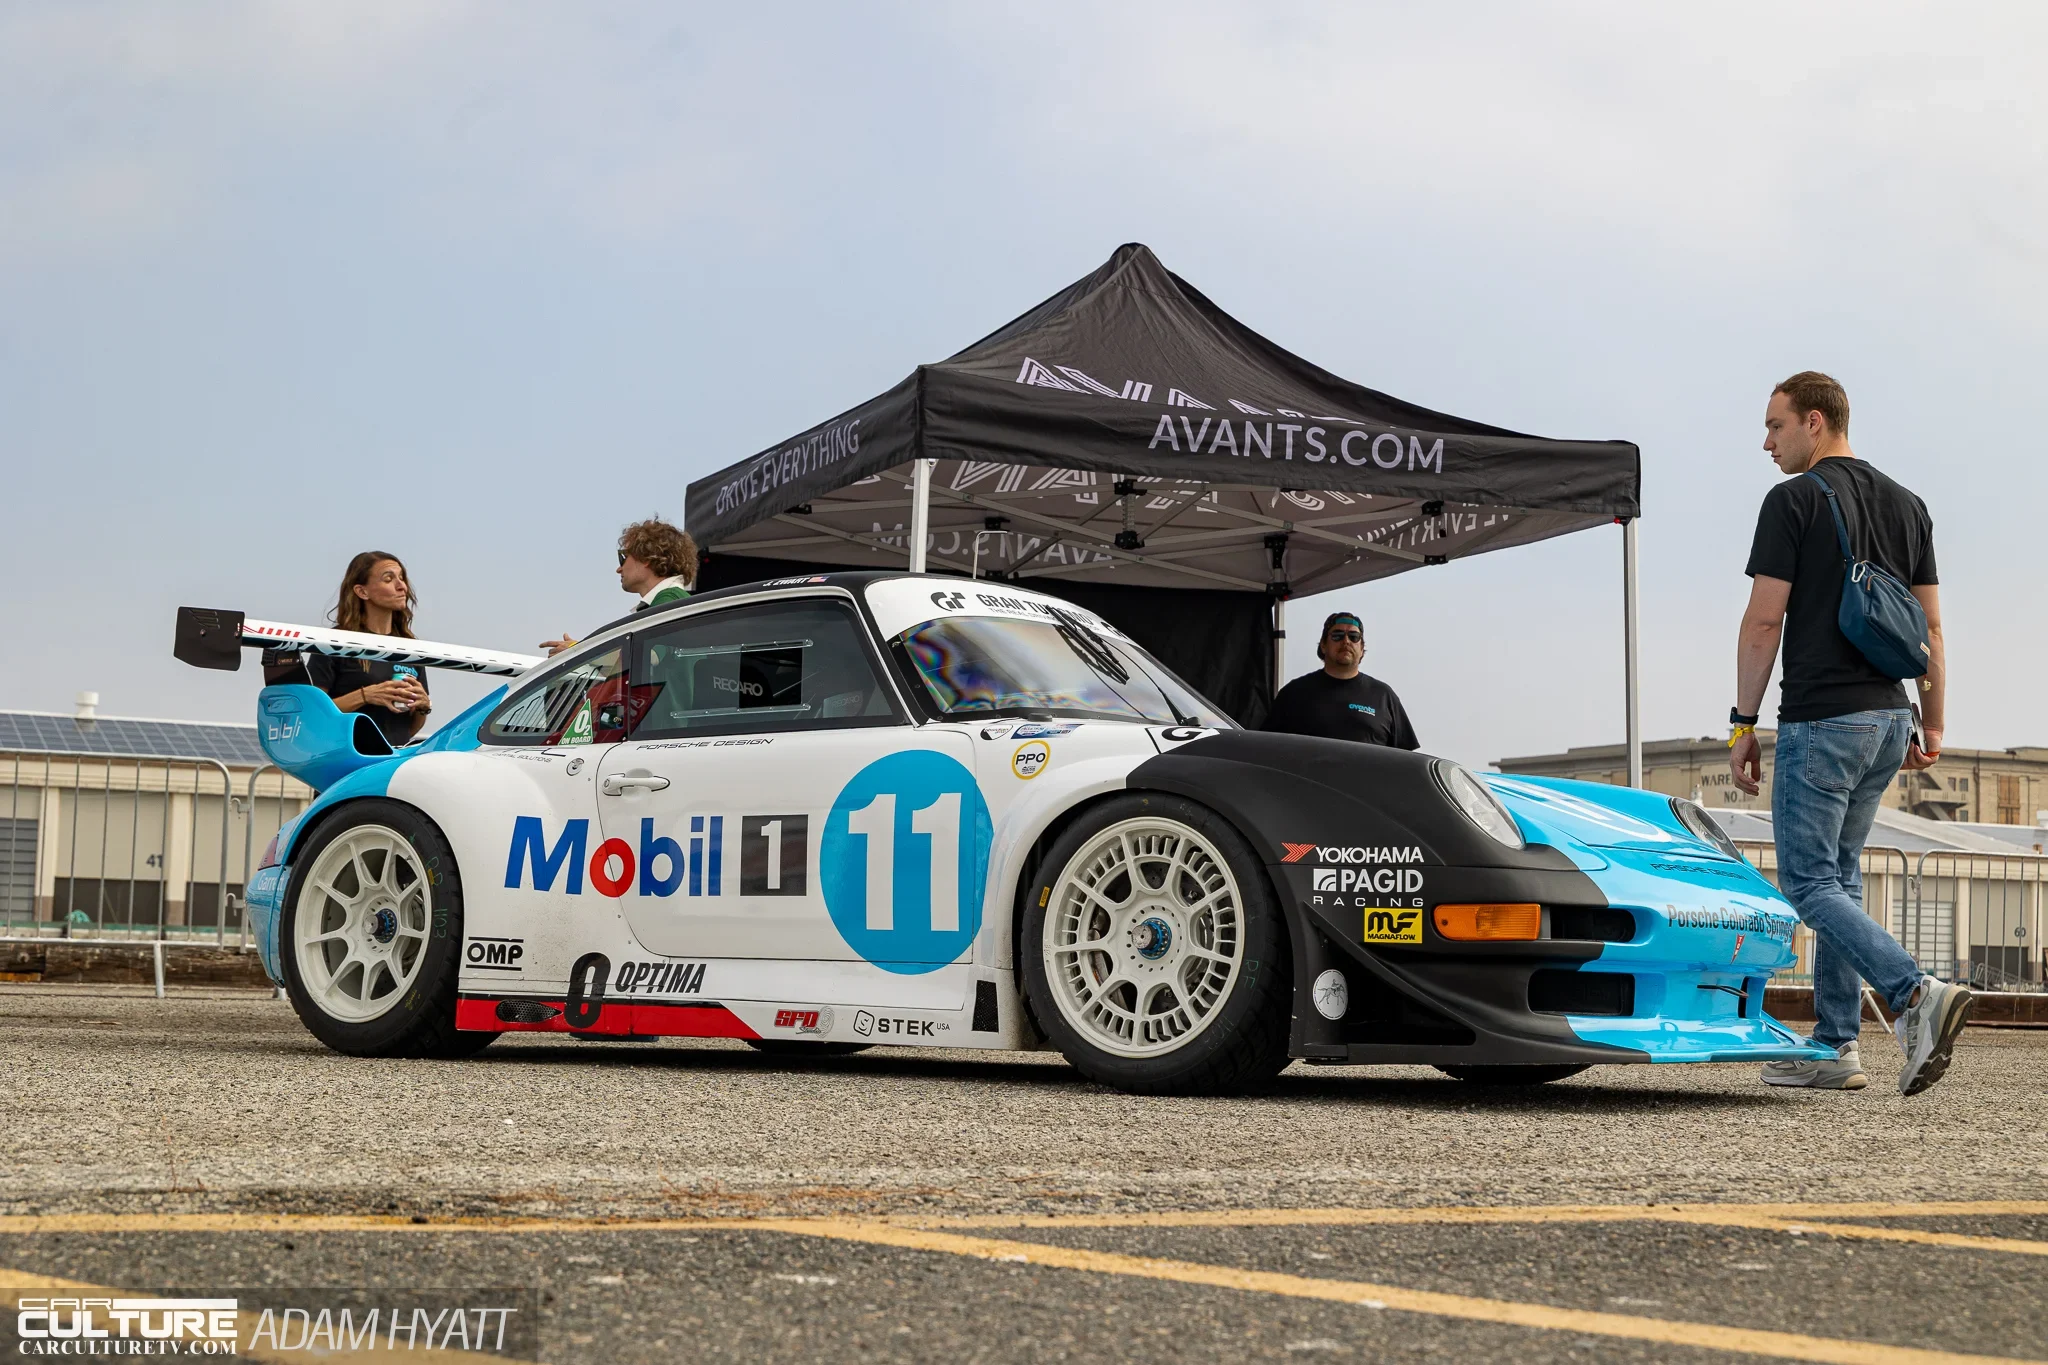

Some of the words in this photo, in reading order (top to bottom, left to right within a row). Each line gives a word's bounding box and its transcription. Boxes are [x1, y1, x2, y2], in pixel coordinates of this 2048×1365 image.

[1148, 414, 1444, 474] AVANTS.COM
[715, 466, 760, 516] DRIVE
[760, 419, 861, 494] EVERYTHING
[975, 593, 1026, 611] GRAN
[713, 676, 764, 697] RECARO
[561, 737, 570, 745] ON
[571, 735, 591, 744] BOARD
[636, 741, 712, 751] PORSCHE
[713, 738, 774, 748] DESIGN
[1015, 752, 1047, 766] PPO
[1701, 771, 1767, 787] WAREE
[146, 854, 163, 868] 41
[504, 815, 724, 899] Mobil
[759, 820, 783, 890] 1
[847, 791, 963, 933] 11
[1315, 846, 1425, 864] YOKOHAMA
[1341, 868, 1424, 893] PAGID
[1313, 895, 1424, 908] RACING
[1666, 904, 1719, 928] Porsche
[1719, 907, 1765, 933] Colorado
[1764, 912, 1794, 944] Springs
[1367, 933, 1416, 941] MAGNAFLOW
[466, 942, 524, 965] OMP
[615, 961, 707, 994] OPTIMA
[878, 1017, 935, 1037] STEK
[936, 1022, 951, 1032] USA
